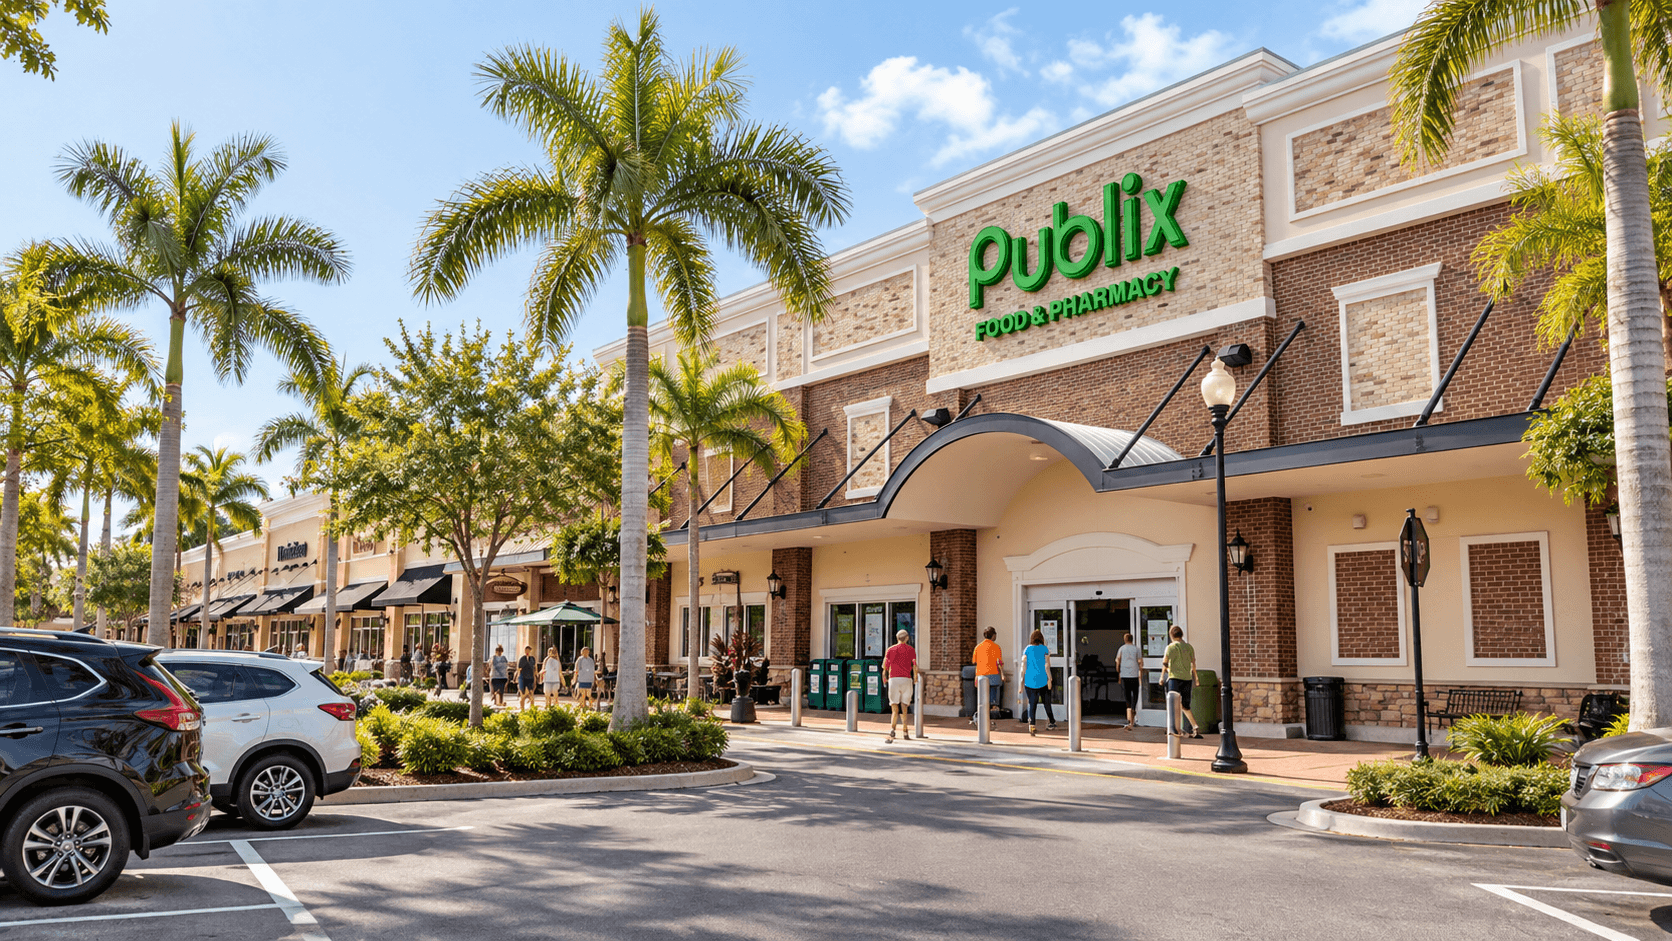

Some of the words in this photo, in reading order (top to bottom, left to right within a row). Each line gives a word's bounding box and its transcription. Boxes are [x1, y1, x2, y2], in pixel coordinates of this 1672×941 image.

[969, 172, 1189, 309] Publix
[976, 310, 1031, 341] FOOD
[1031, 305, 1049, 326] &
[1049, 266, 1180, 321] PHARMACY
